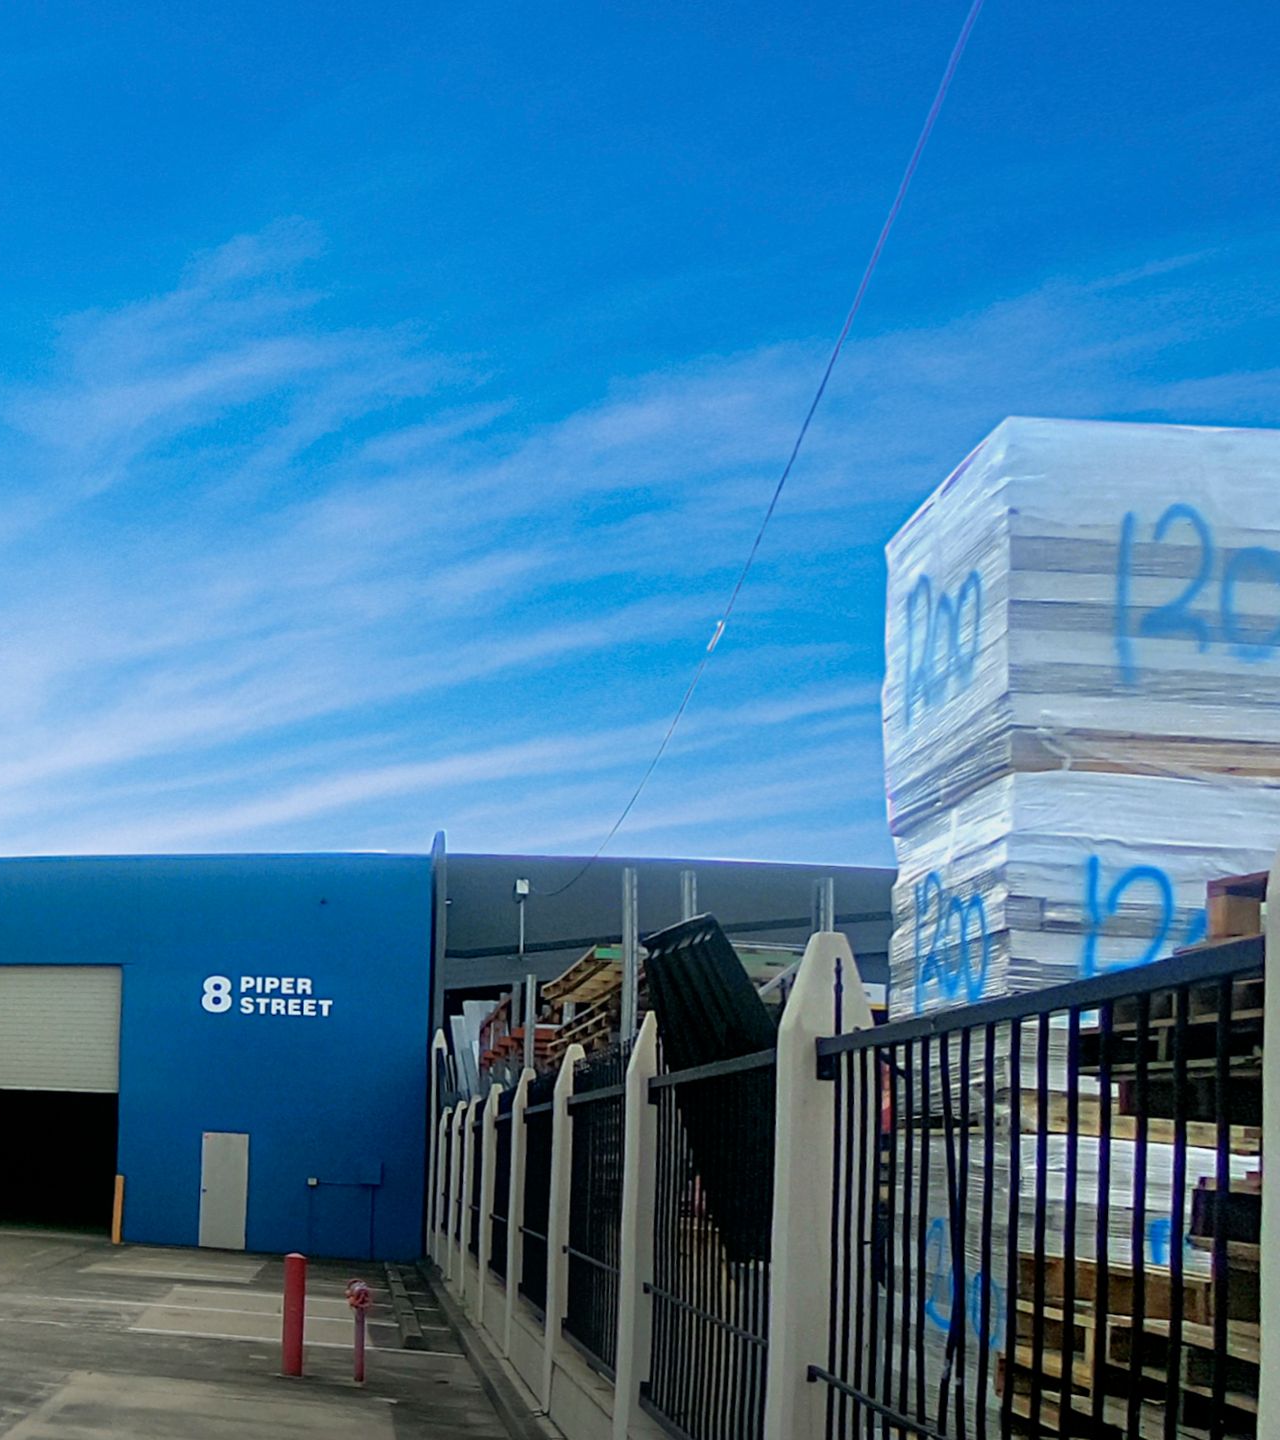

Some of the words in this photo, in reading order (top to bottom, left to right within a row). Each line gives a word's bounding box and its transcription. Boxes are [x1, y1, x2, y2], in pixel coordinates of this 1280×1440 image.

[201, 975, 232, 1013] 8
[240, 976, 313, 995] PIPER
[240, 997, 333, 1017] STREET
